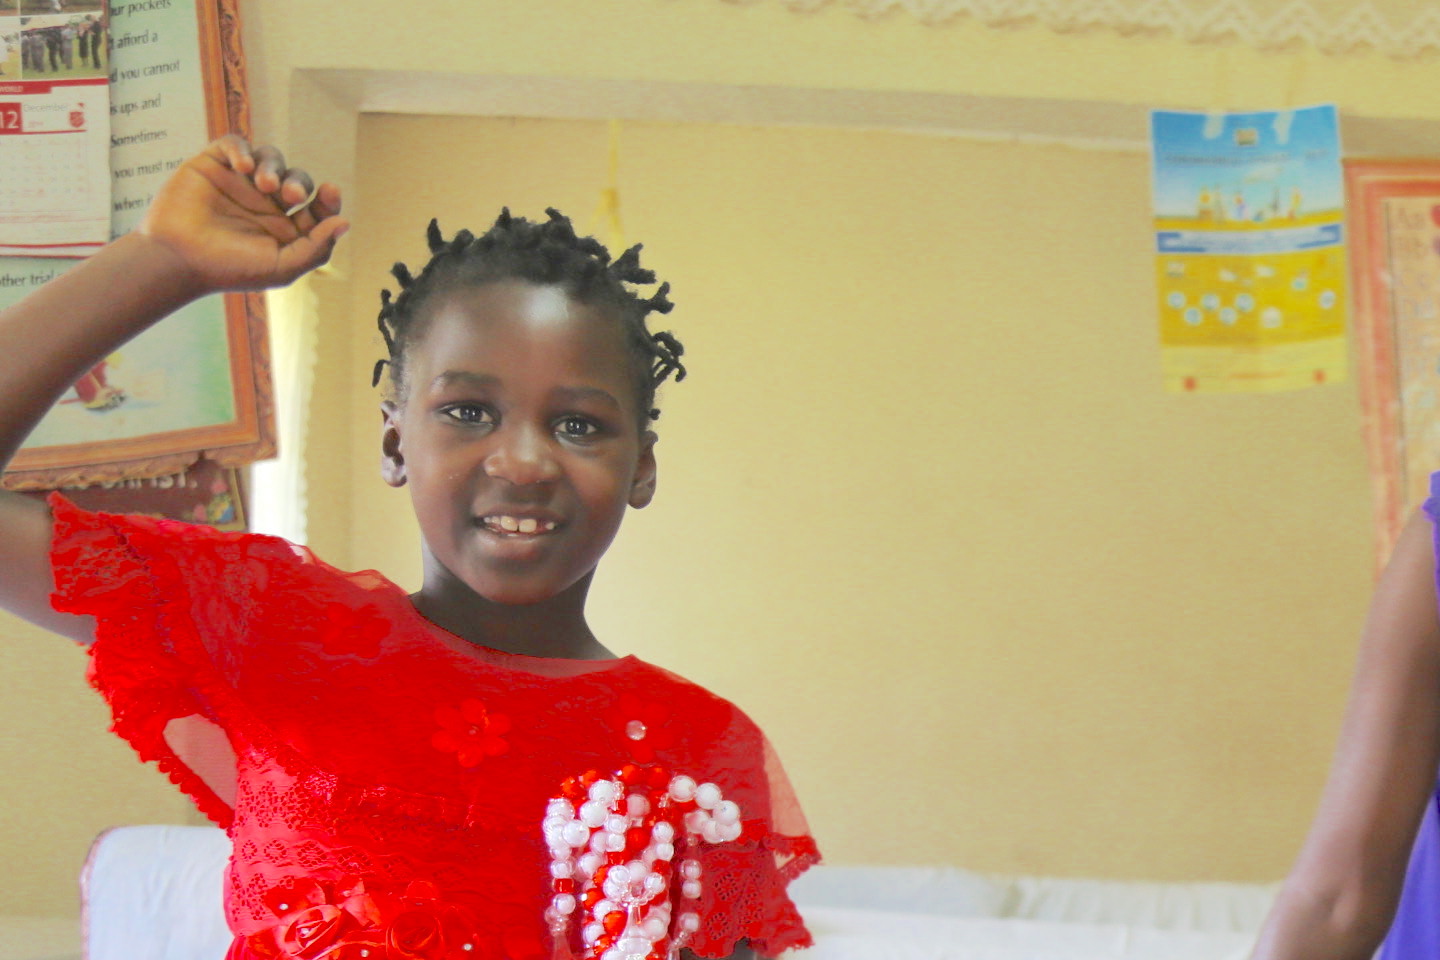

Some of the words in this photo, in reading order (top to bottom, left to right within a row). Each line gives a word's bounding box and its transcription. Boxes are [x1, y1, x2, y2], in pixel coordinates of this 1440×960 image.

[128, 0, 172, 17] pockets
[117, 29, 149, 49] afford
[152, 32, 158, 43] a
[120, 67, 140, 85] you
[143, 59, 180, 76] cannot
[120, 101, 138, 116] ups
[142, 92, 161, 110] and
[110, 128, 168, 149] Sometimes
[114, 166, 134, 185] you
[137, 159, 162, 175] must
[114, 196, 144, 211] when
